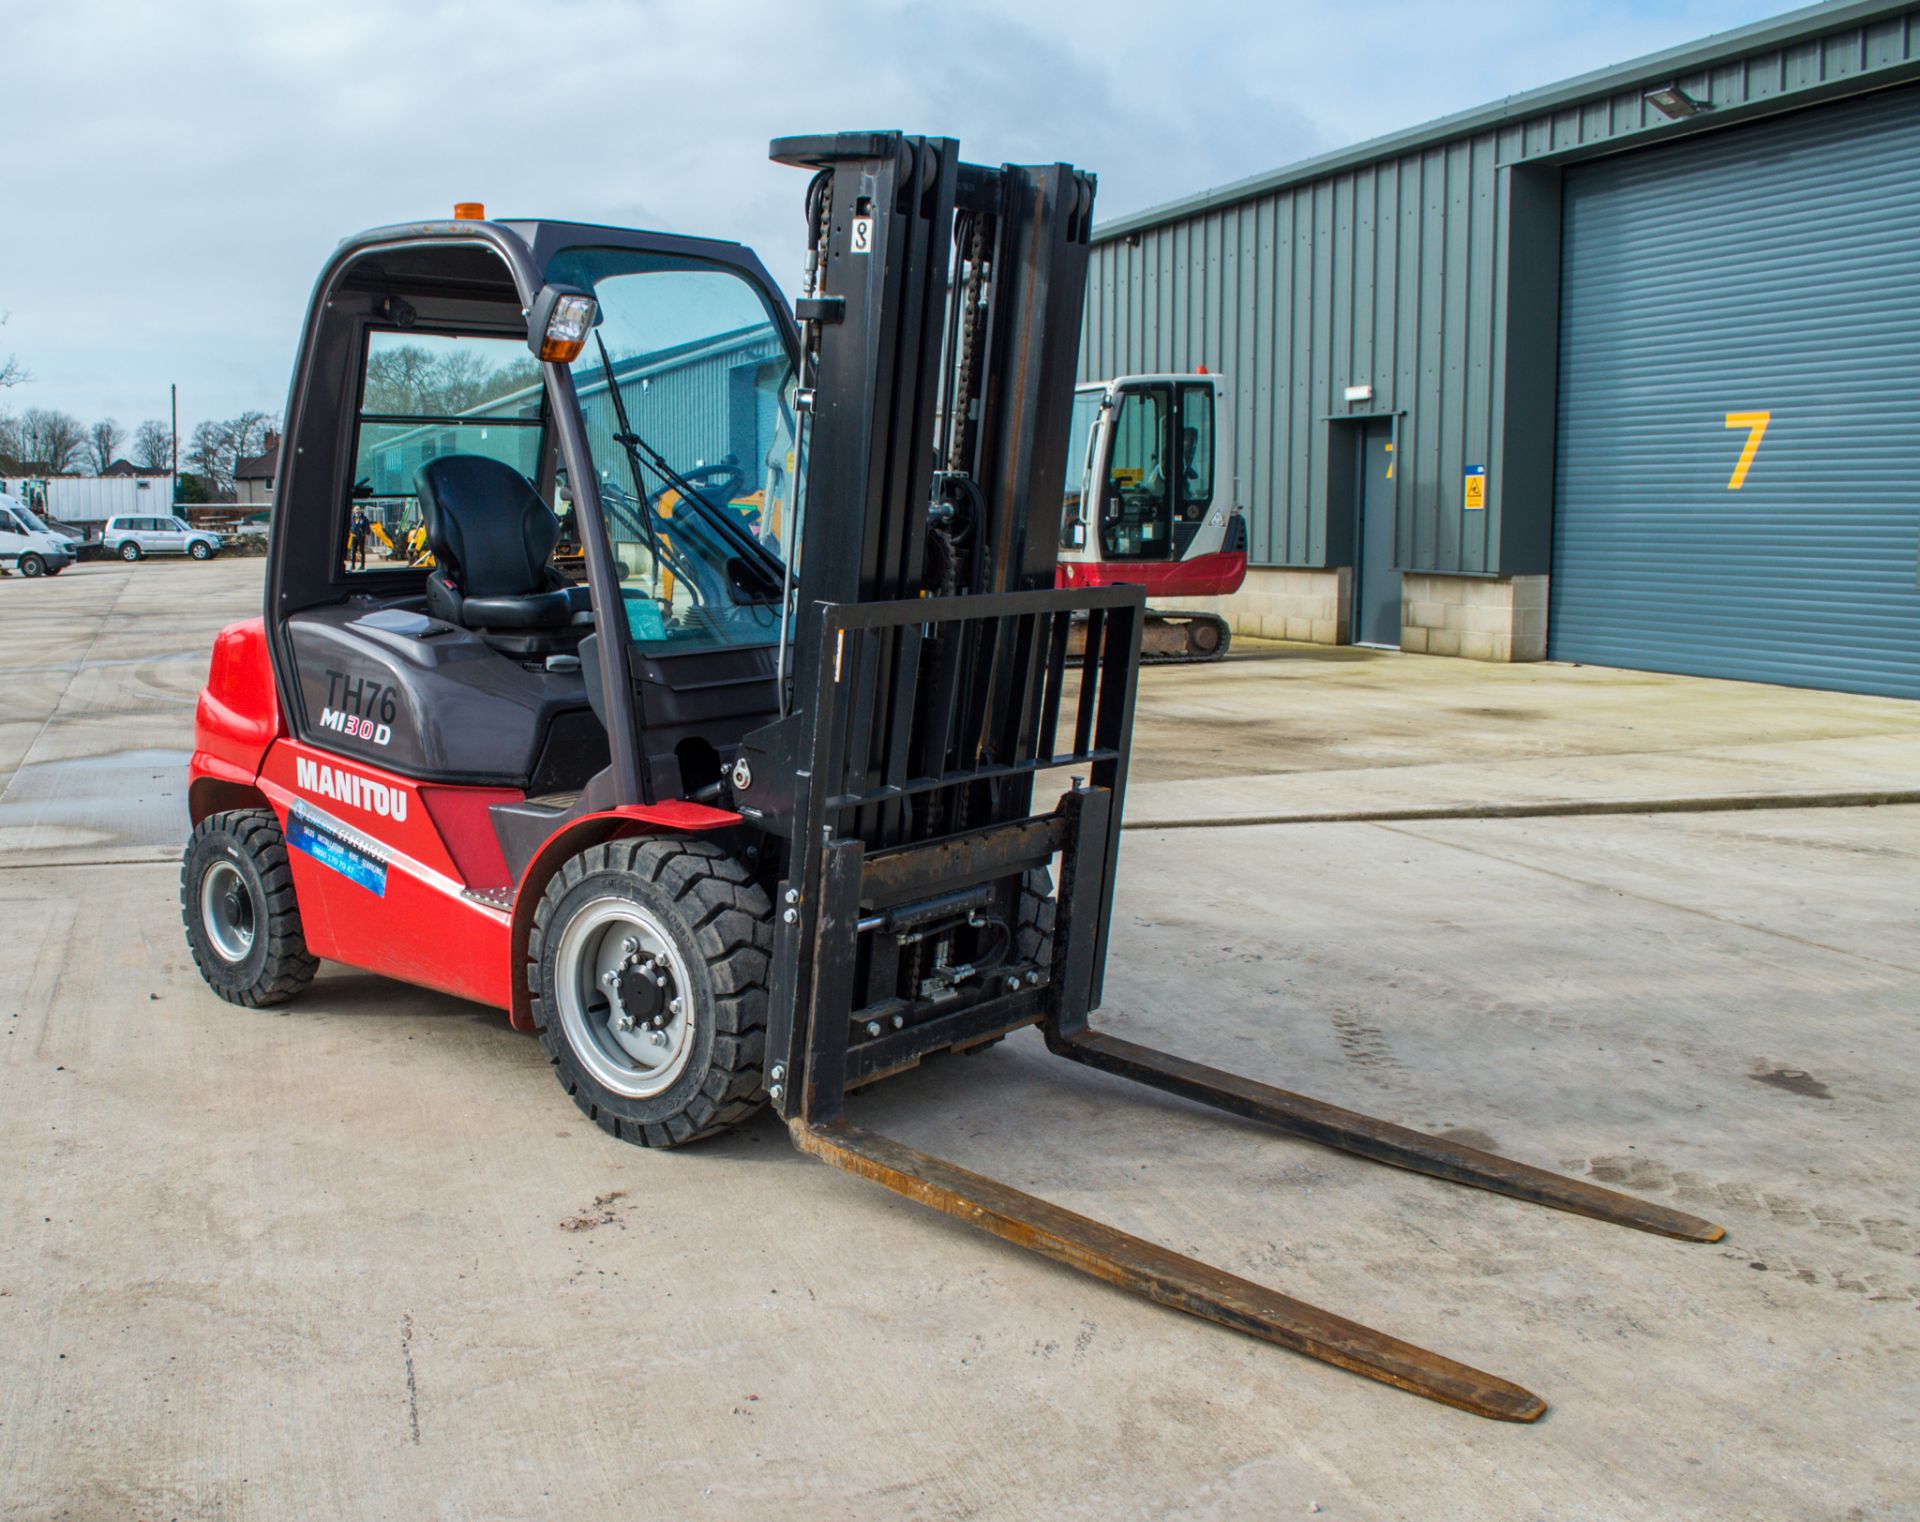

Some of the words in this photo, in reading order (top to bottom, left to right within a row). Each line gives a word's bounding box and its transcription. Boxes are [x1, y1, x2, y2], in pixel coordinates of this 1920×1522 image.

[1725, 411, 1771, 490] 7
[326, 669, 398, 725] TH76
[296, 756, 407, 823] MANITOU
